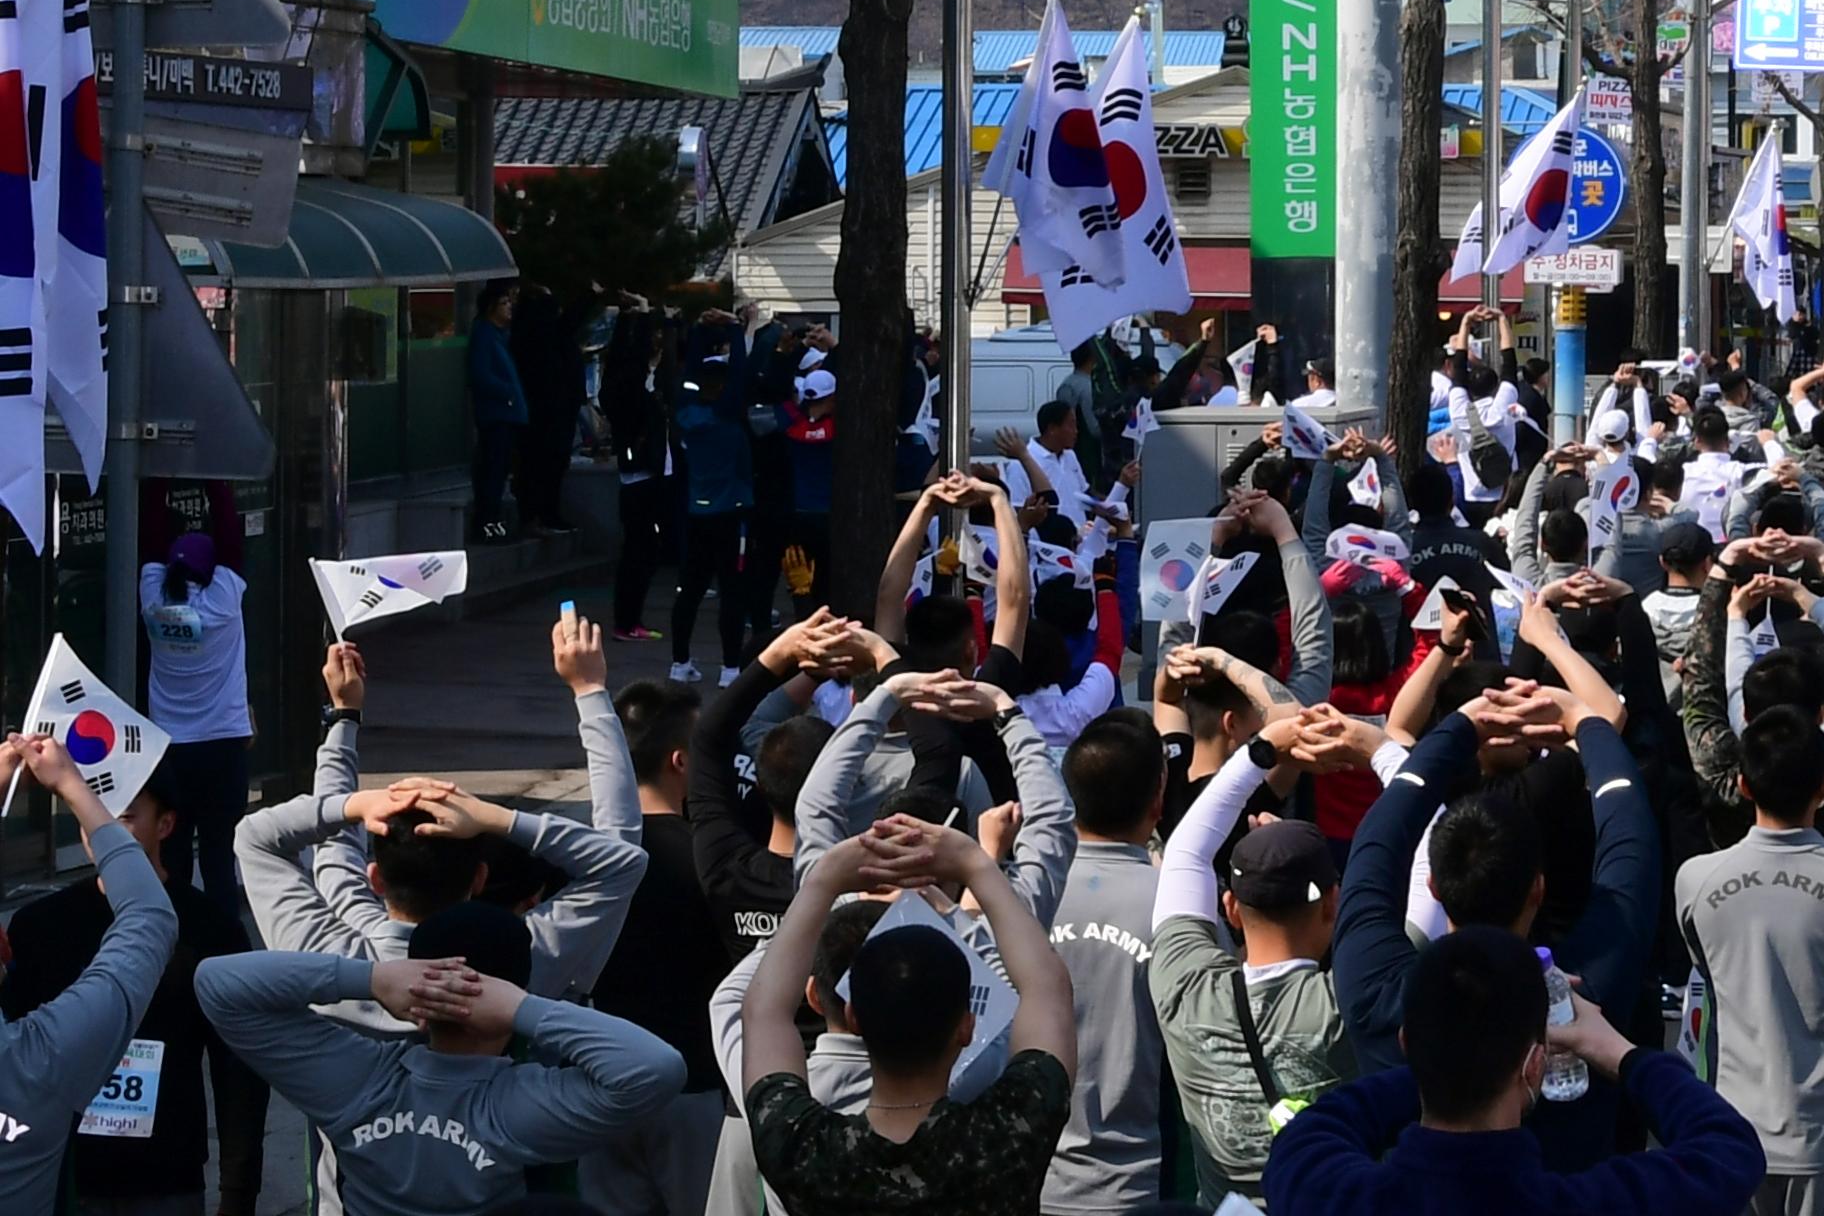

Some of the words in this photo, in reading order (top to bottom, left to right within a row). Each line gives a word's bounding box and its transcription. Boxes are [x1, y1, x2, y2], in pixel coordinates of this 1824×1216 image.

[1763, 15, 1781, 35] P
[204, 63, 282, 100] T.442-7528
[1598, 80, 1631, 93] PIZZ
[1590, 93, 1633, 108] 피자스
[1411, 548, 1435, 566] OK
[160, 623, 194, 638] 228
[1706, 870, 1763, 909] ROK
[1083, 922, 1153, 965] ARMY
[352, 1111, 415, 1148] ROK
[417, 1114, 496, 1172] ARMY
